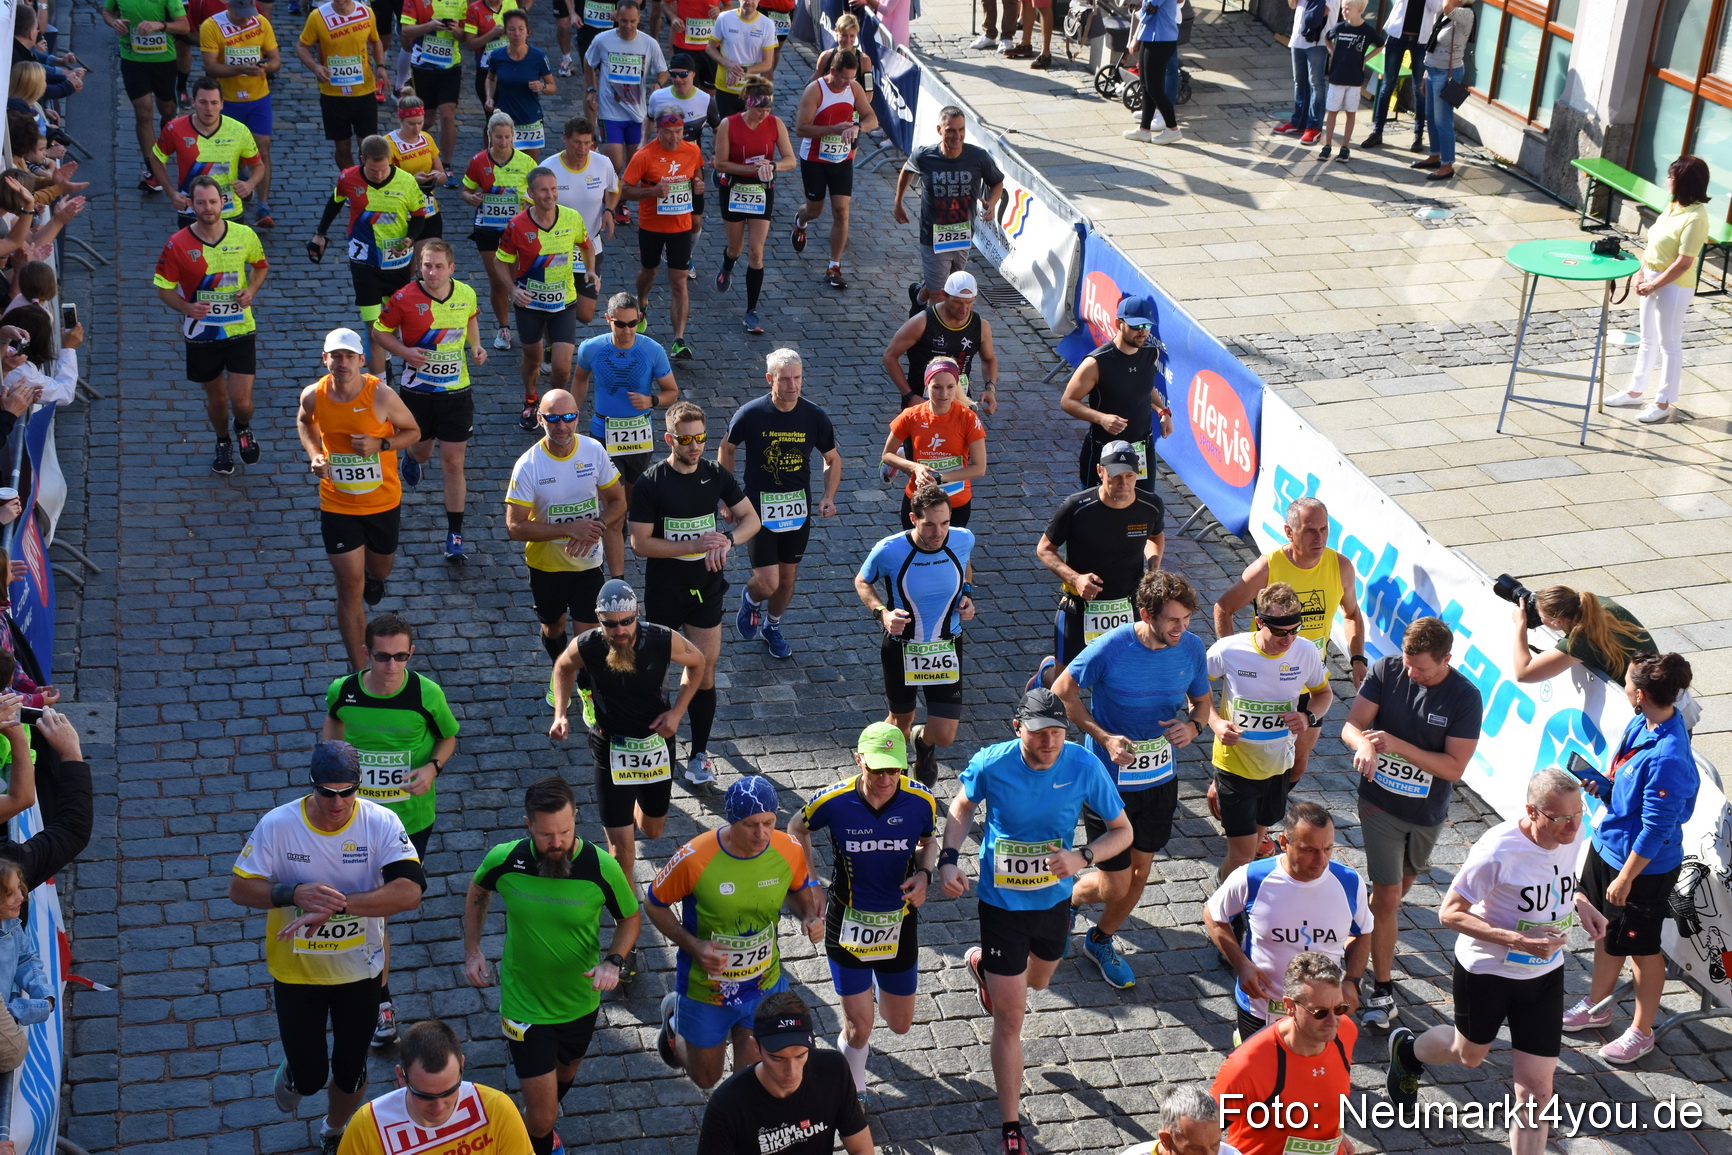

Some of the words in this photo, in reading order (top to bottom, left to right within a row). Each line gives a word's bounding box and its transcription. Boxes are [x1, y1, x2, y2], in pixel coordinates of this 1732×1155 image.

[587, 10, 611, 20] 2783
[330, 29, 350, 40] MAX
[352, 22, 371, 33] BÖGL
[134, 36, 164, 46] 1290
[226, 37, 244, 47] MAX
[426, 44, 451, 57] 2688
[329, 57, 358, 65] BOCK
[611, 55, 639, 64] BOCK
[332, 66, 358, 76] 2404
[612, 64, 637, 75] 2771
[516, 131, 542, 141] 2772
[823, 144, 848, 153] 2576
[401, 152, 417, 161] MAX
[932, 171, 973, 185] MUD
[735, 183, 764, 192] BOCK
[933, 184, 972, 198] DER
[485, 195, 515, 203] BOCK
[662, 192, 689, 204] 2160
[734, 192, 762, 203] 2575
[935, 196, 971, 210] NAT
[486, 205, 516, 216] 2845
[662, 204, 689, 212] HARTMUT
[735, 203, 759, 211] ANDREA
[938, 232, 968, 243] 2825
[530, 280, 563, 291] BOCK
[530, 291, 563, 303] 2690
[207, 303, 240, 315] 679
[422, 363, 458, 375] 2685
[607, 416, 648, 429] BOCK
[1192, 374, 1252, 473] Hervis
[611, 428, 648, 443] 1211
[768, 430, 806, 438] Neumarkter
[616, 443, 644, 452] DANIEL
[1199, 432, 1222, 464] SPORTS
[332, 454, 376, 465] BOCK
[574, 462, 584, 470] 20
[335, 466, 375, 481] 1381
[764, 493, 802, 503] BOCK
[551, 500, 597, 514] BOCK
[767, 502, 803, 519] 2120
[667, 518, 711, 531] BOCK
[778, 519, 794, 528] UWE
[1088, 601, 1130, 613] BOCK
[1091, 614, 1129, 631] 1009
[1301, 615, 1326, 623] RSCH
[907, 642, 952, 655] BOCK
[911, 654, 953, 671] 1246
[1279, 664, 1290, 672] 20
[913, 672, 951, 680] MICHAEL
[1238, 701, 1288, 713] BOCK
[1238, 714, 1286, 731] 2764
[617, 750, 663, 768] 1347
[1126, 749, 1169, 770] 2818
[618, 768, 664, 780] MATTHIAS
[1377, 757, 1425, 783] 2594
[359, 768, 404, 786] 156
[1376, 773, 1421, 794] GÜNTHER
[357, 787, 401, 798] TORSTEN
[845, 828, 874, 836] TEAM
[342, 842, 357, 852] 20
[845, 838, 909, 853] BOCK
[998, 841, 1056, 856] BOCK
[655, 842, 697, 889] BOCK
[1006, 876, 1050, 886] MARKUS
[850, 910, 903, 927] BOCK
[850, 925, 895, 945] 1007
[1271, 922, 1338, 949] SUSPA
[307, 940, 340, 952] Harry
[723, 944, 769, 968] 278
[721, 964, 763, 979] NIKOLAI
[757, 1124, 801, 1146] SWIM.
